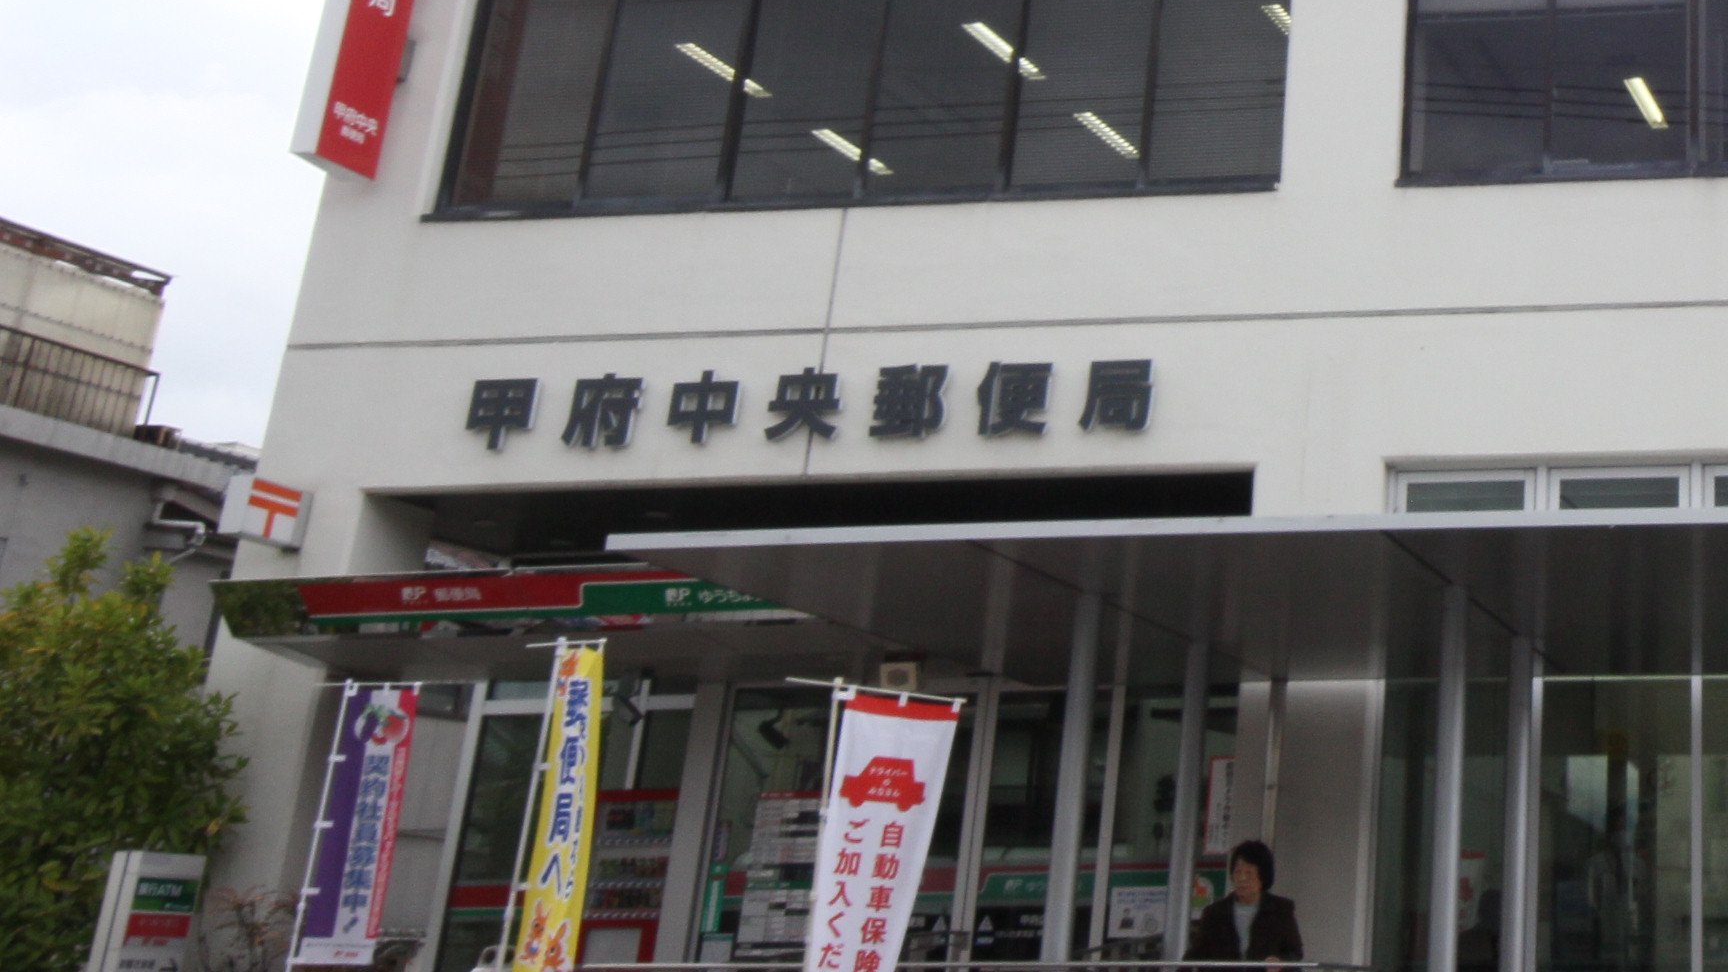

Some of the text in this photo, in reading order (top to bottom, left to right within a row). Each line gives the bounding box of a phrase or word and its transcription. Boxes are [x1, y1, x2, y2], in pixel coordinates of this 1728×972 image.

[465, 358, 1155, 451] 甲府中央郵便局
[818, 818, 869, 969] ご加入くだ
[853, 821, 905, 972] 自動車保険
